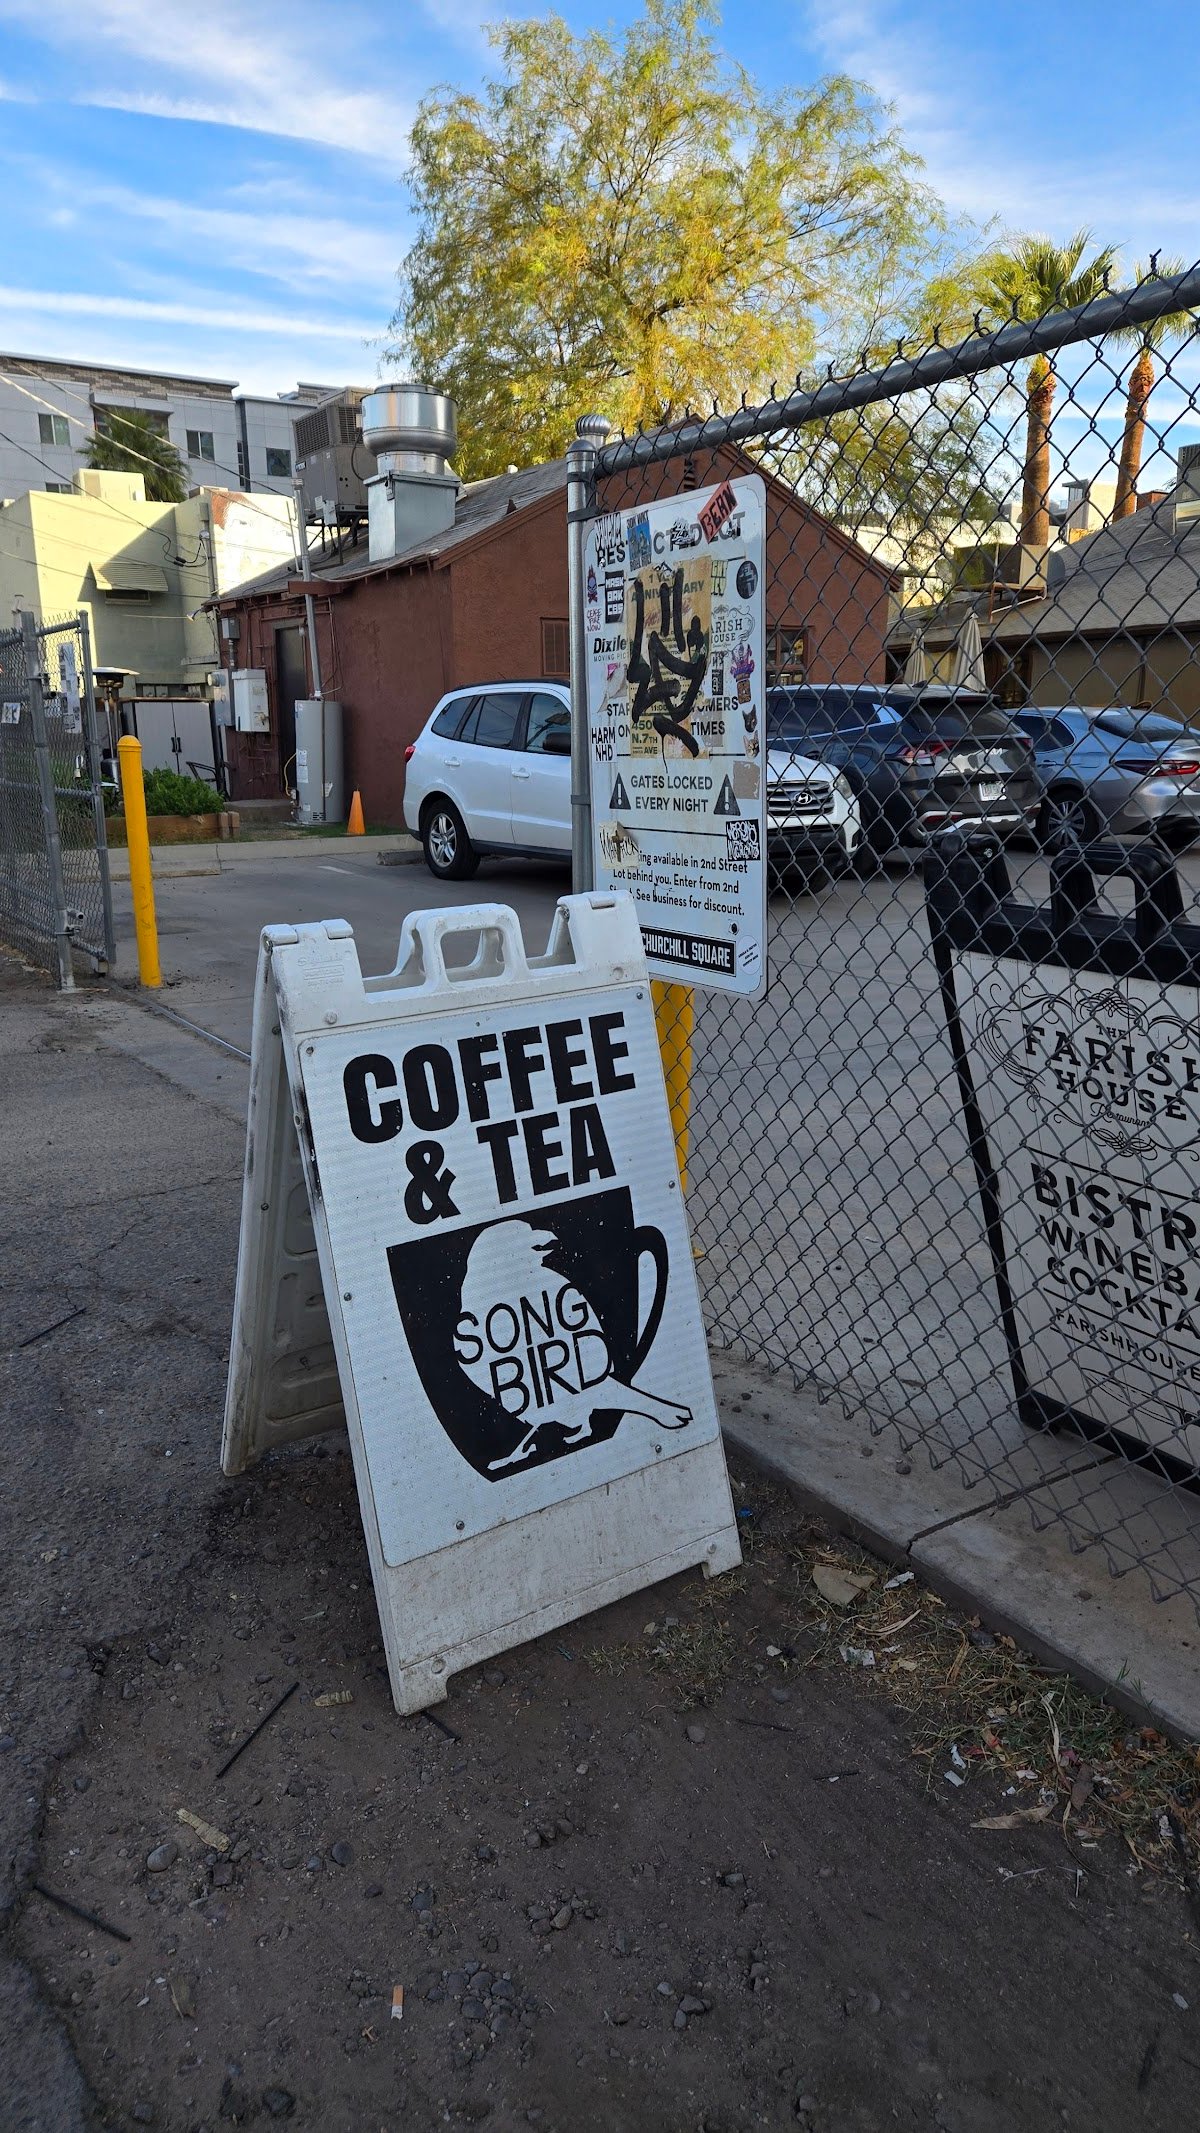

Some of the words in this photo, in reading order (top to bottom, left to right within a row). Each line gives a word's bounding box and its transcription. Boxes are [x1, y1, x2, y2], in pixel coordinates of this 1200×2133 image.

[591, 726, 616, 744] HARM
[691, 721, 725, 736] TIMES
[596, 744, 613, 761] NHD
[631, 775, 664, 789] GATES
[668, 775, 712, 790] LOCKED
[635, 796, 670, 811] EVERY
[673, 798, 709, 813] NIGHT
[653, 852, 689, 867] available
[690, 855, 699, 868] in
[700, 857, 716, 870] 2nd
[719, 858, 748, 873] Street
[613, 869, 626, 879] Lot
[627, 869, 653, 883] behind
[655, 877, 672, 887] you.
[673, 873, 697, 888] Enter
[699, 876, 721, 892] from
[722, 880, 739, 894] 2nd
[636, 888, 651, 902] See
[653, 889, 687, 907] business
[689, 895, 702, 909] for
[704, 897, 745, 916] discount.
[691, 942, 731, 969] SQUARE
[1096, 1025, 1127, 1040] THE
[343, 1011, 636, 1144] COFFEE
[1055, 1069, 1187, 1121] HOUSE
[404, 1139, 461, 1225] &
[476, 1103, 616, 1204] TEA
[454, 1282, 590, 1365] SONG
[489, 1329, 613, 1418] BIRD
